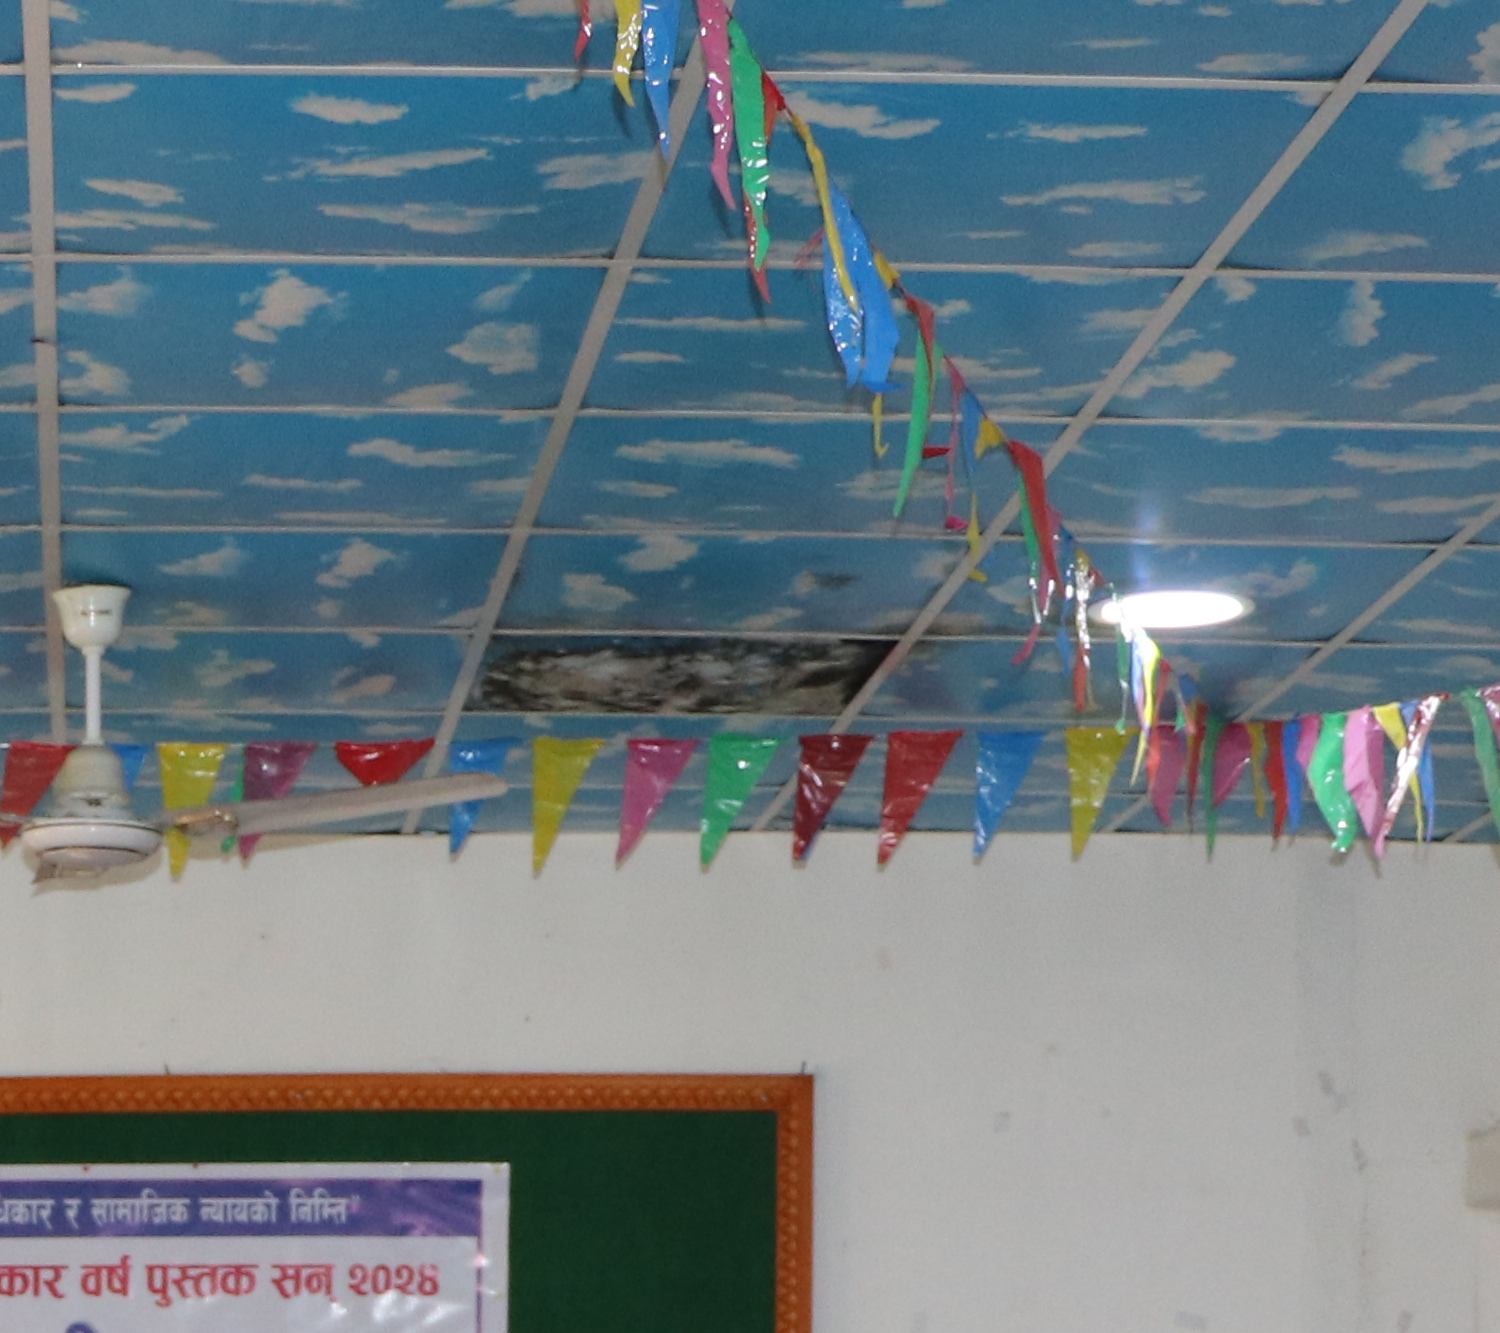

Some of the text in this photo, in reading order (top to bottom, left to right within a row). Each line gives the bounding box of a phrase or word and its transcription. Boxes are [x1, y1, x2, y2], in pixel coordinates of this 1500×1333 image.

[63, 1198, 82, 1230] र
[91, 1187, 190, 1227] सामाजिक
[199, 1190, 279, 1224] न्यायको
[80, 1254, 131, 1298] वर्ष
[145, 1263, 258, 1308] पुस्तक
[271, 1263, 338, 1302] सन्
[348, 1263, 440, 1298] २०२४
